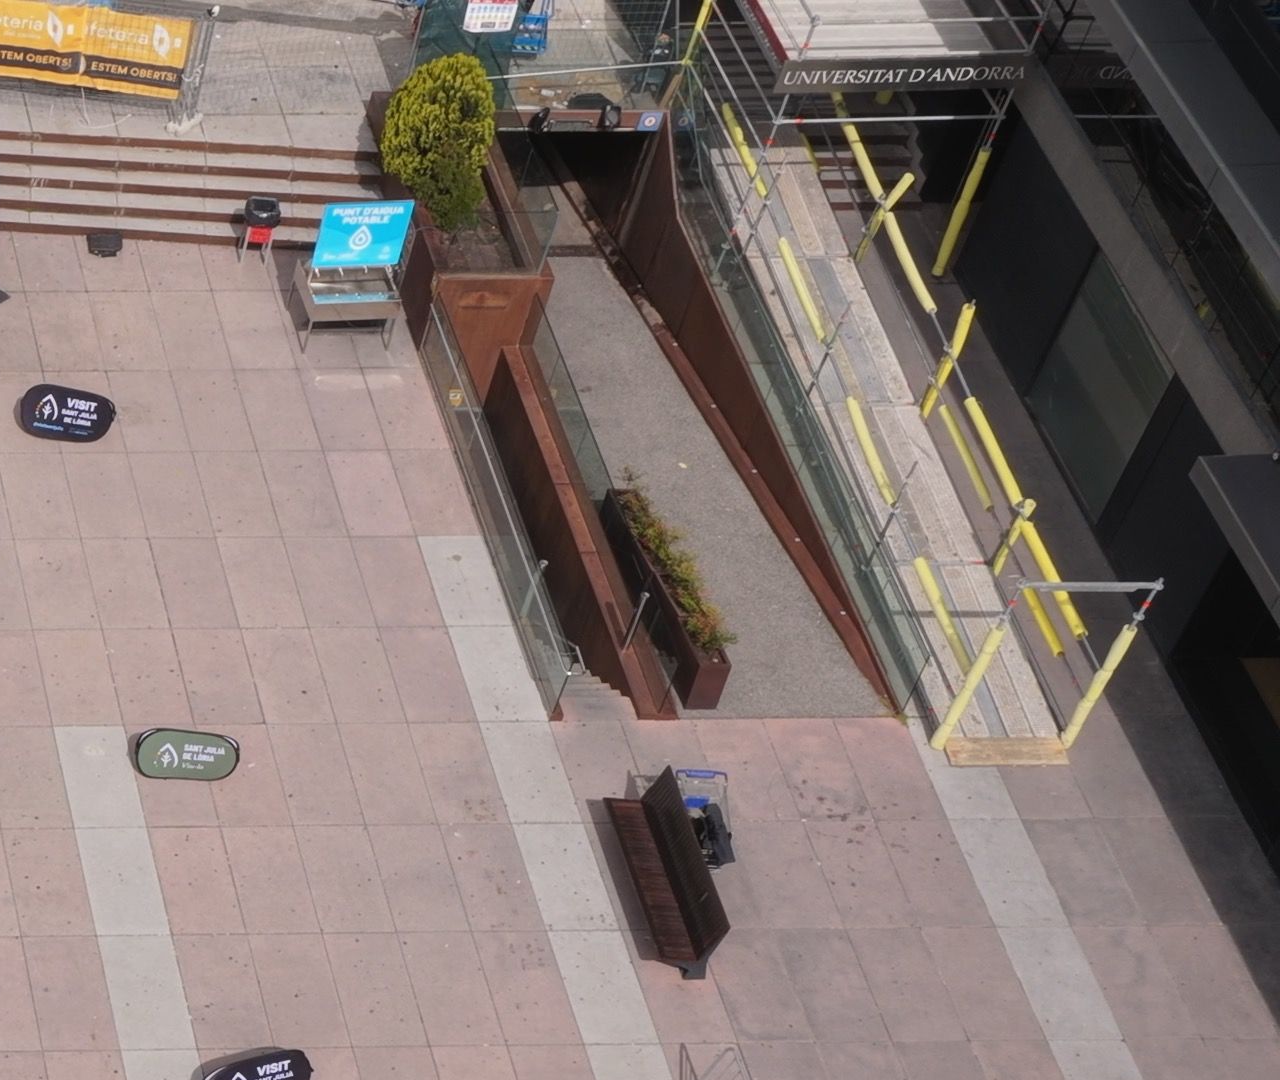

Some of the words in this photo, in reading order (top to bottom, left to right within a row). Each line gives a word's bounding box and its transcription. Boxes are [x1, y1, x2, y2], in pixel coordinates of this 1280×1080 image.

[26, 54, 72, 68] OBERTS!
[91, 61, 128, 75] ESTEM
[130, 67, 177, 82] OBERTS!
[783, 69, 907, 86] UNIVERSITAT
[908, 66, 1025, 84] D'ANDORRA
[332, 207, 361, 217] PUNT
[342, 215, 391, 225] POTABLE
[67, 397, 98, 412] VISIT
[61, 408, 79, 417] SANT
[63, 416, 72, 424] DE
[183, 744, 203, 752] SANT
[182, 752, 193, 760] DE
[256, 1060, 291, 1076] VISIT
[273, 1070, 294, 1080] JULIÀ
